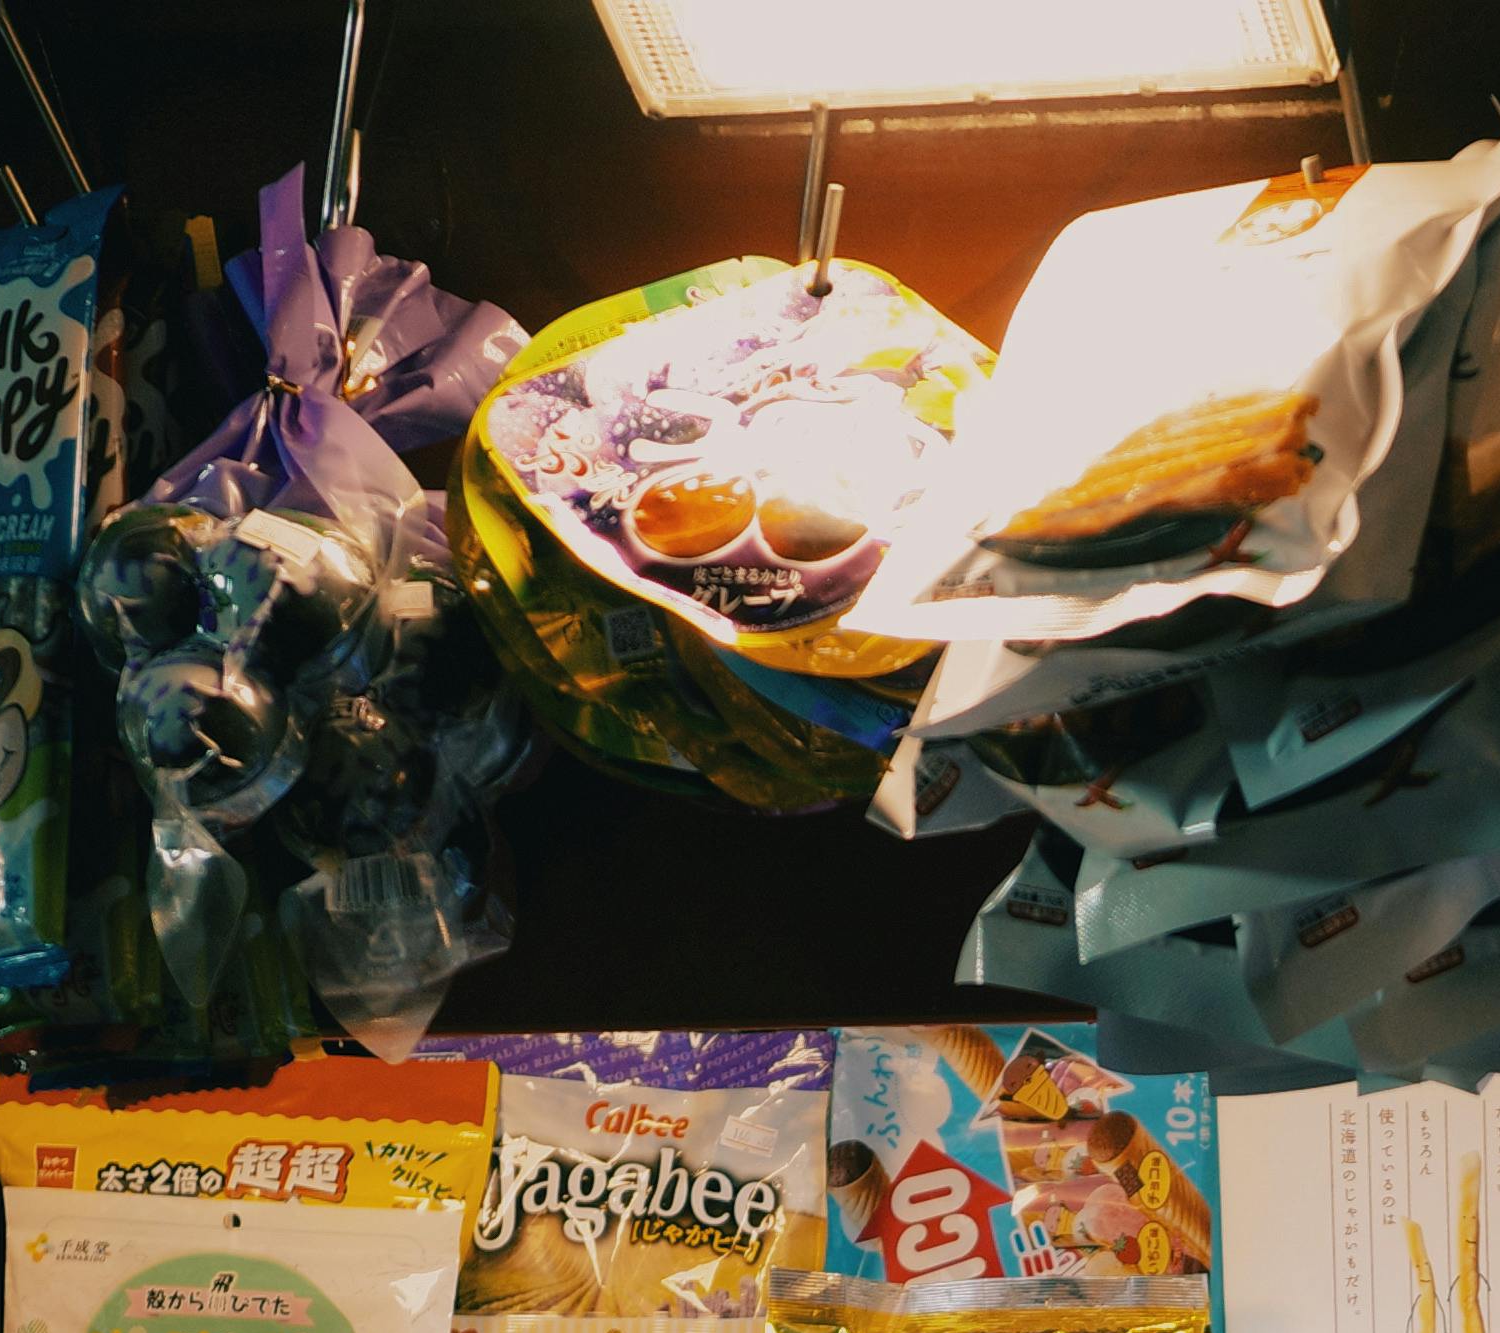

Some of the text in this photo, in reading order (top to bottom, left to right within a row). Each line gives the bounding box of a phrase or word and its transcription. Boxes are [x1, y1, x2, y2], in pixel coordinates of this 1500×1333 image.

[691, 577, 806, 620] グレープ
[585, 1100, 690, 1139] Calbee
[1419, 1109, 1434, 1176] もちろん
[1378, 1108, 1396, 1226] 使っているのは
